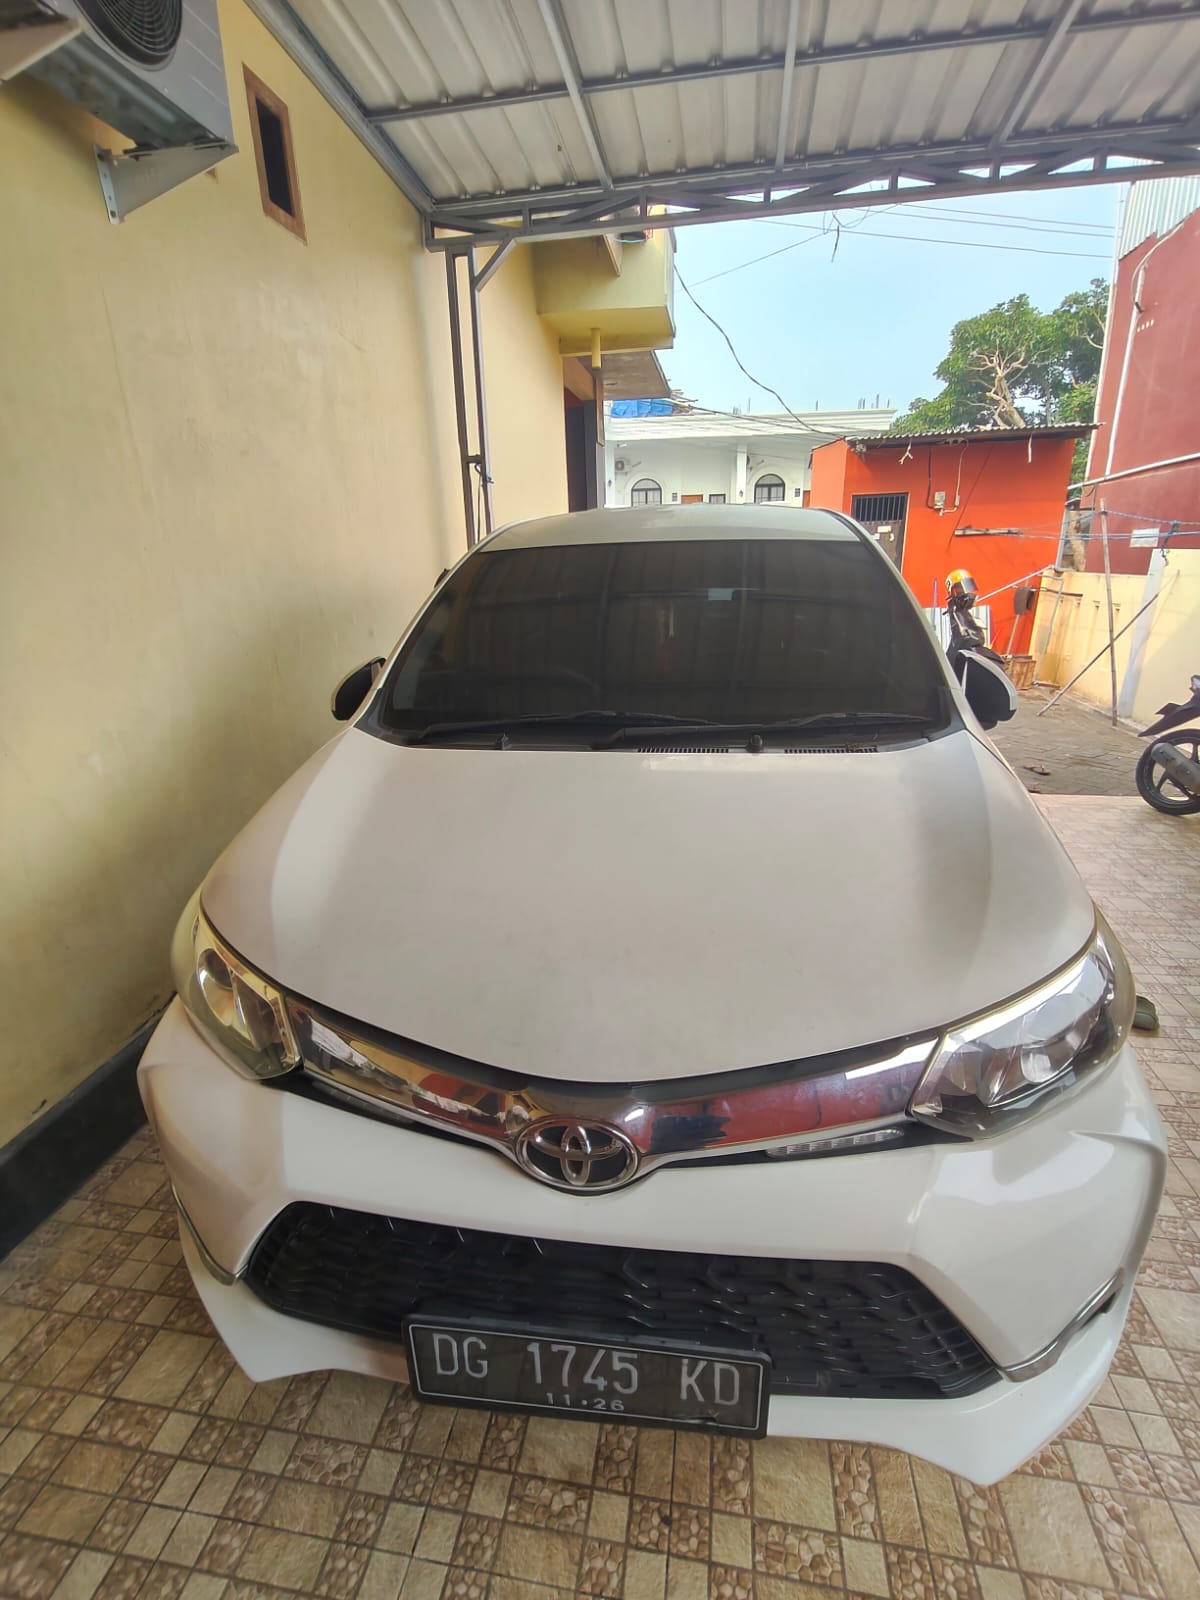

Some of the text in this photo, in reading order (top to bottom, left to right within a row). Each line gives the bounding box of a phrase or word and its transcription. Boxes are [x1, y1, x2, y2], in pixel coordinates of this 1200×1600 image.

[432, 1333, 740, 1406] DG 1745 KD
